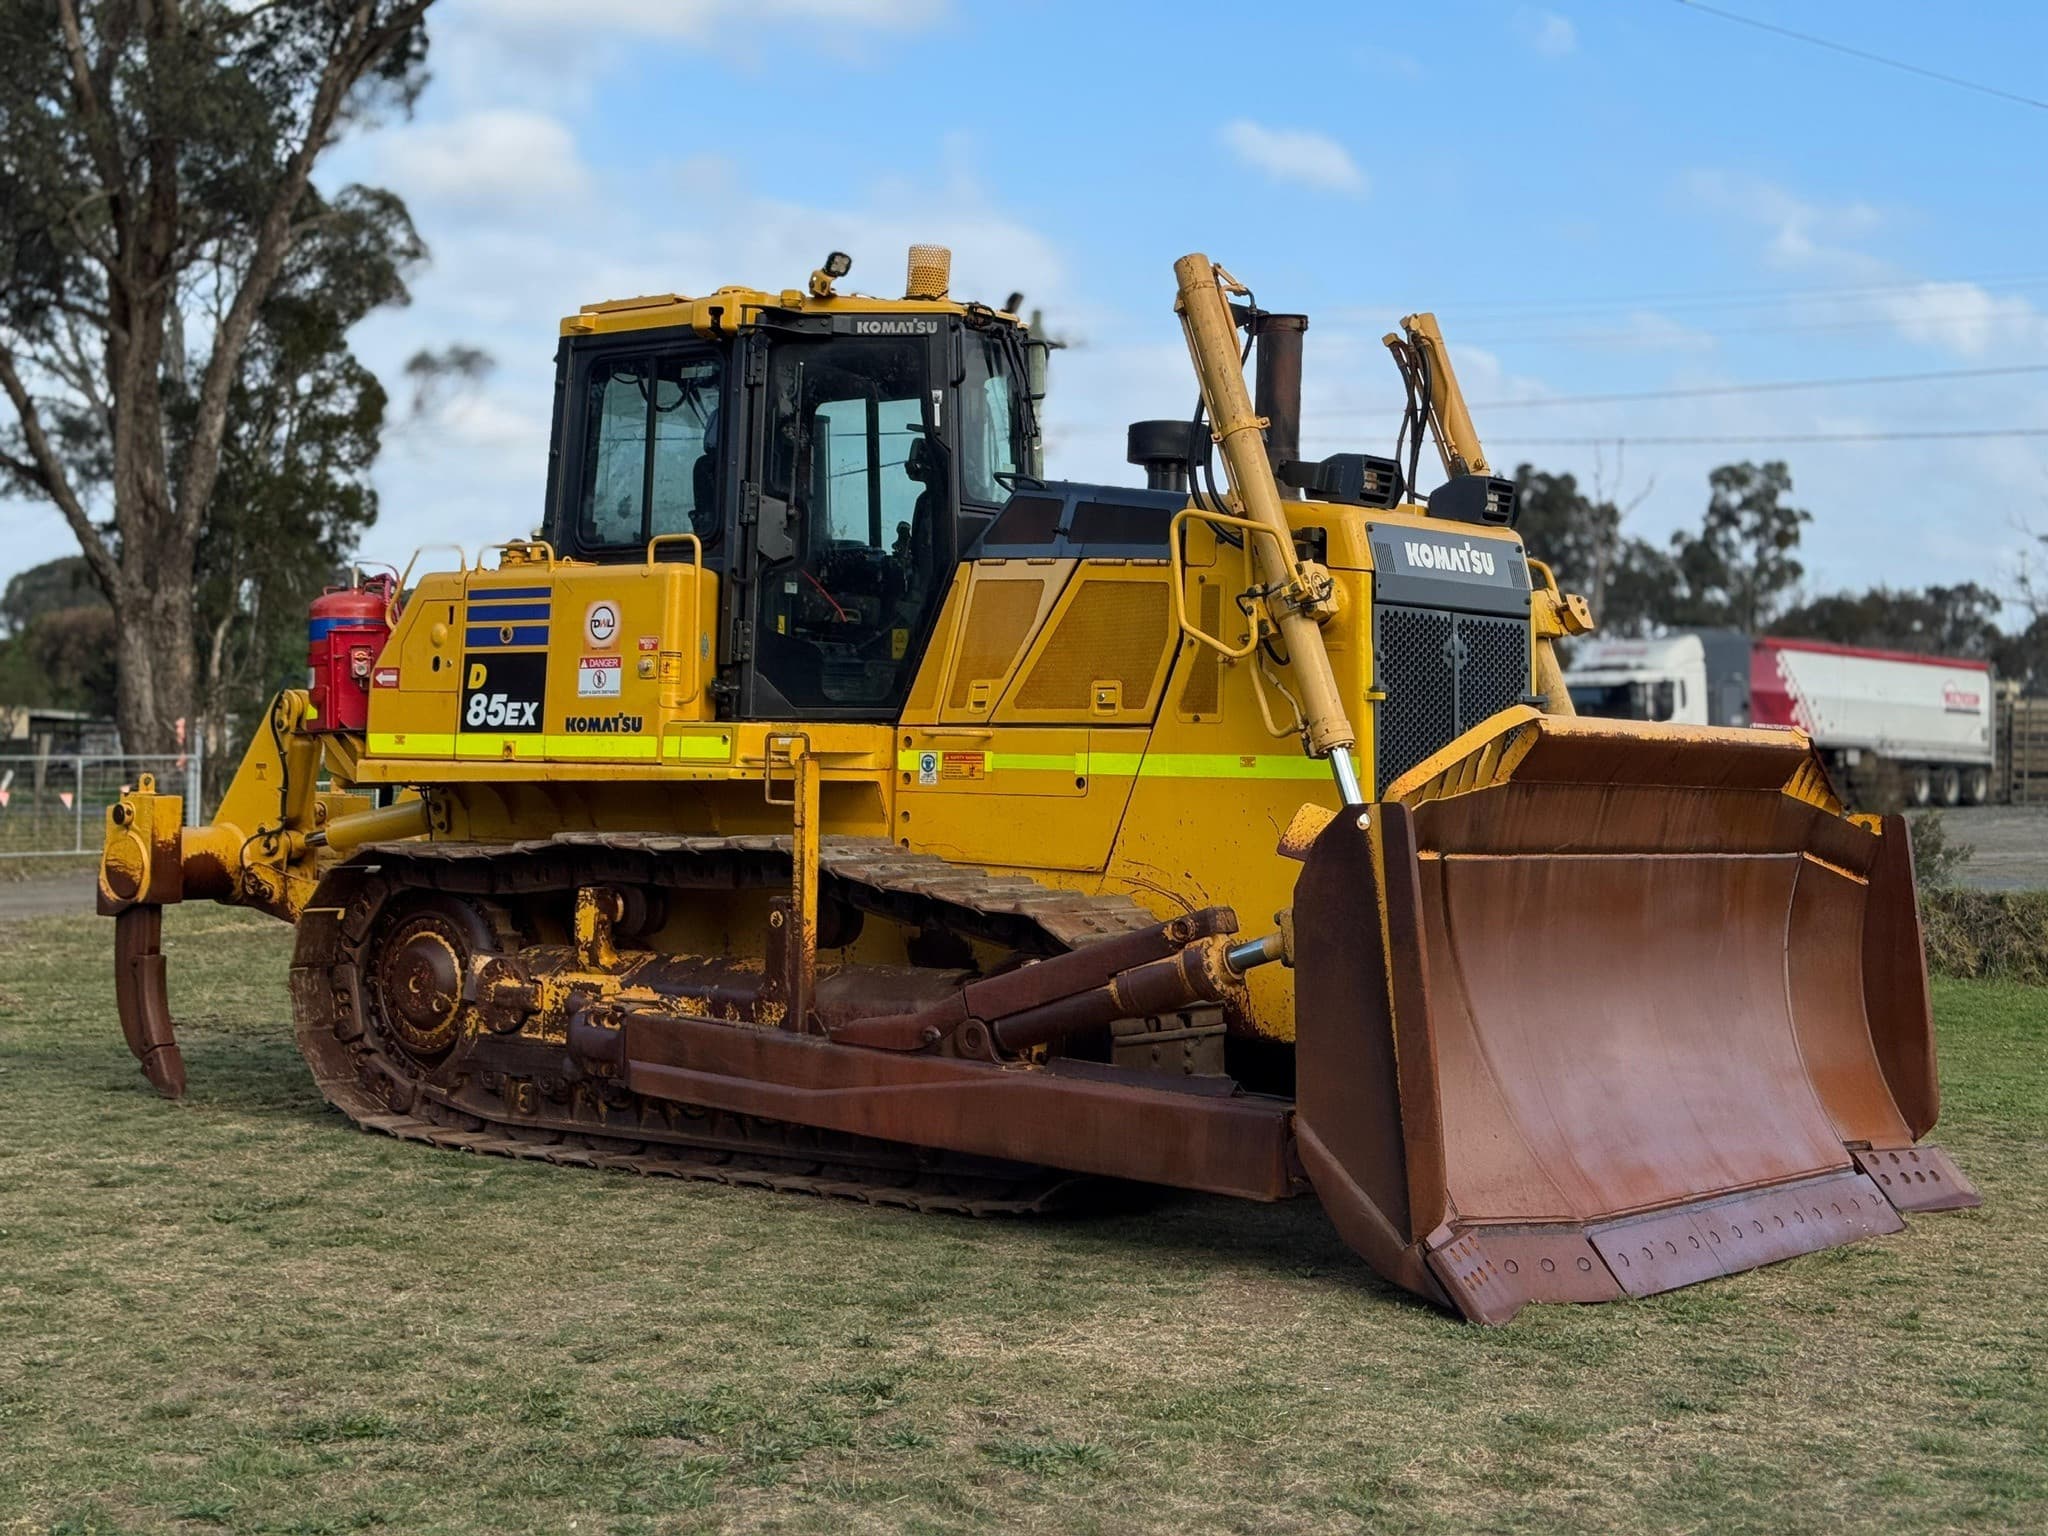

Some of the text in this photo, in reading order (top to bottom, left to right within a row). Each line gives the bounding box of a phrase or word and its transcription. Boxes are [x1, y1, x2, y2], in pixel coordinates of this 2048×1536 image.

[856, 318, 938, 334] KOMATSU
[1404, 541, 1495, 576] KOMATSU
[589, 658, 619, 668] DANGER
[467, 663, 488, 690] D
[466, 693, 539, 727] 85EX
[565, 712, 643, 733] KOMATSU
